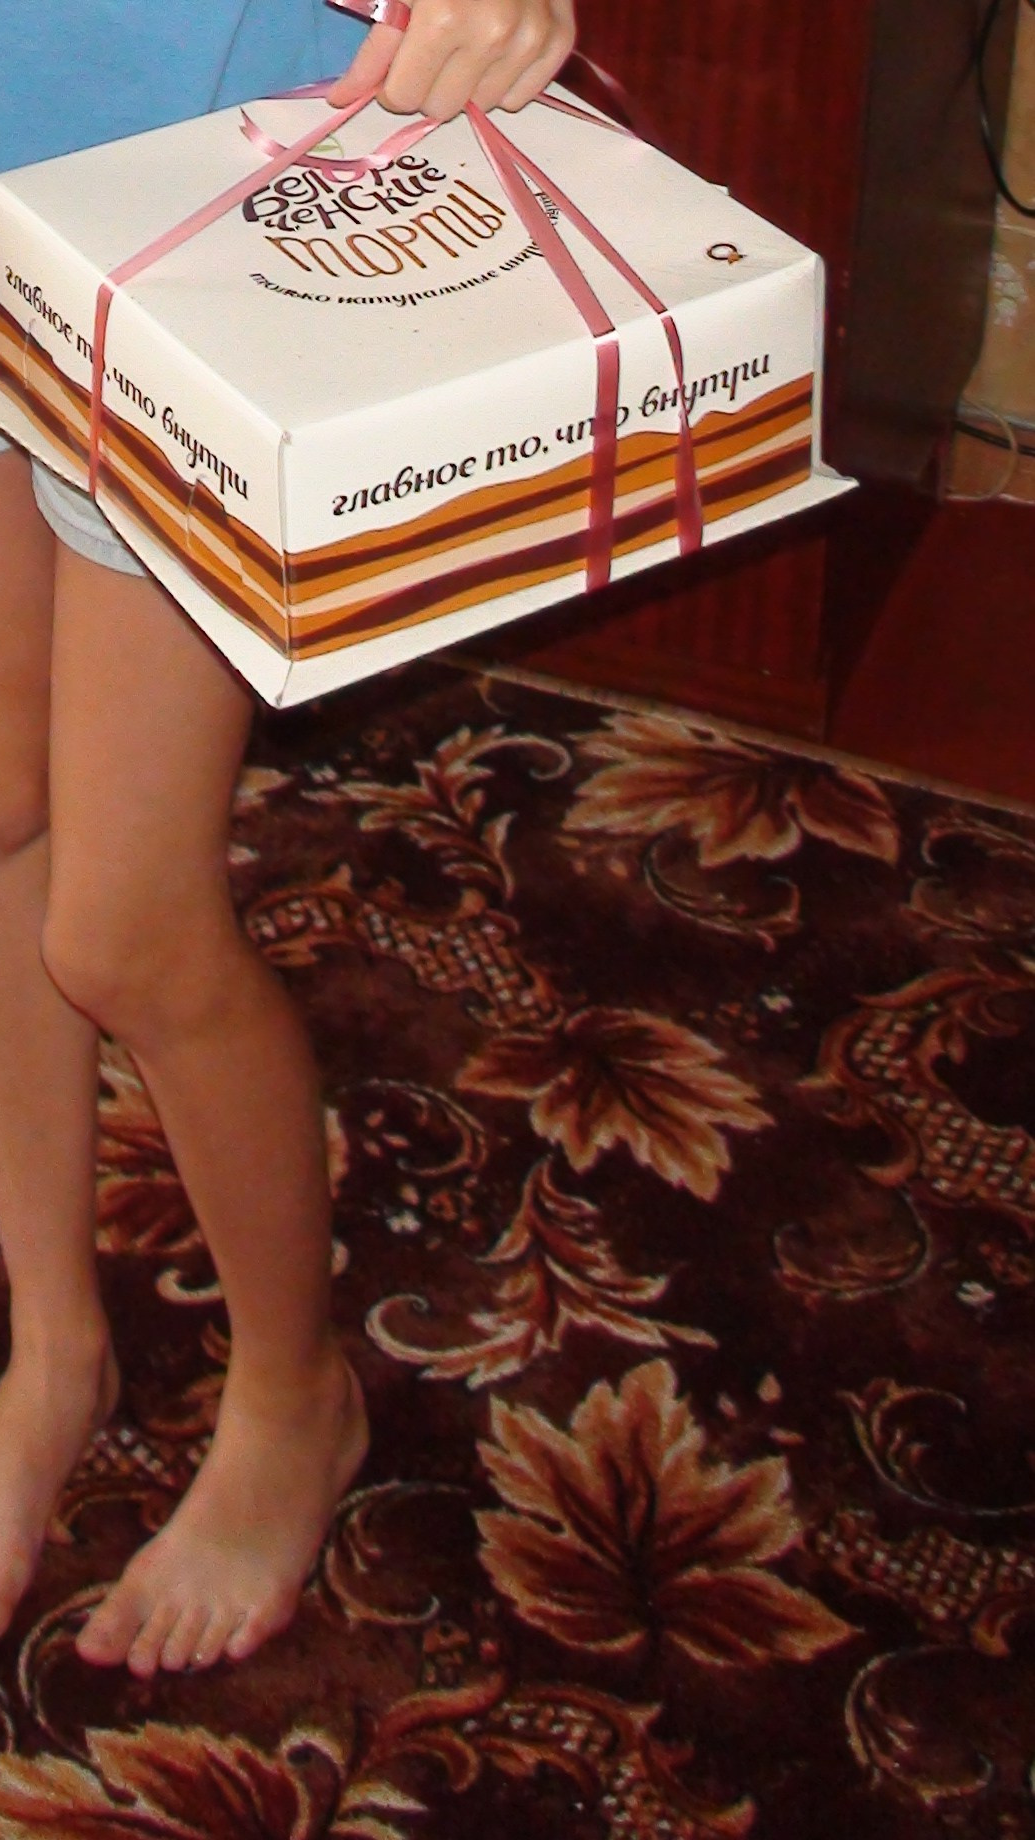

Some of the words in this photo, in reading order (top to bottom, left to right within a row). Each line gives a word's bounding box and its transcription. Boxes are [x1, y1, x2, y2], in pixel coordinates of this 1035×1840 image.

[337, 269, 500, 307] натуральные
[5, 265, 73, 344] главное
[113, 367, 156, 419] что
[162, 406, 249, 500] внутри
[332, 455, 477, 517] главное
[638, 354, 770, 418] внутри
